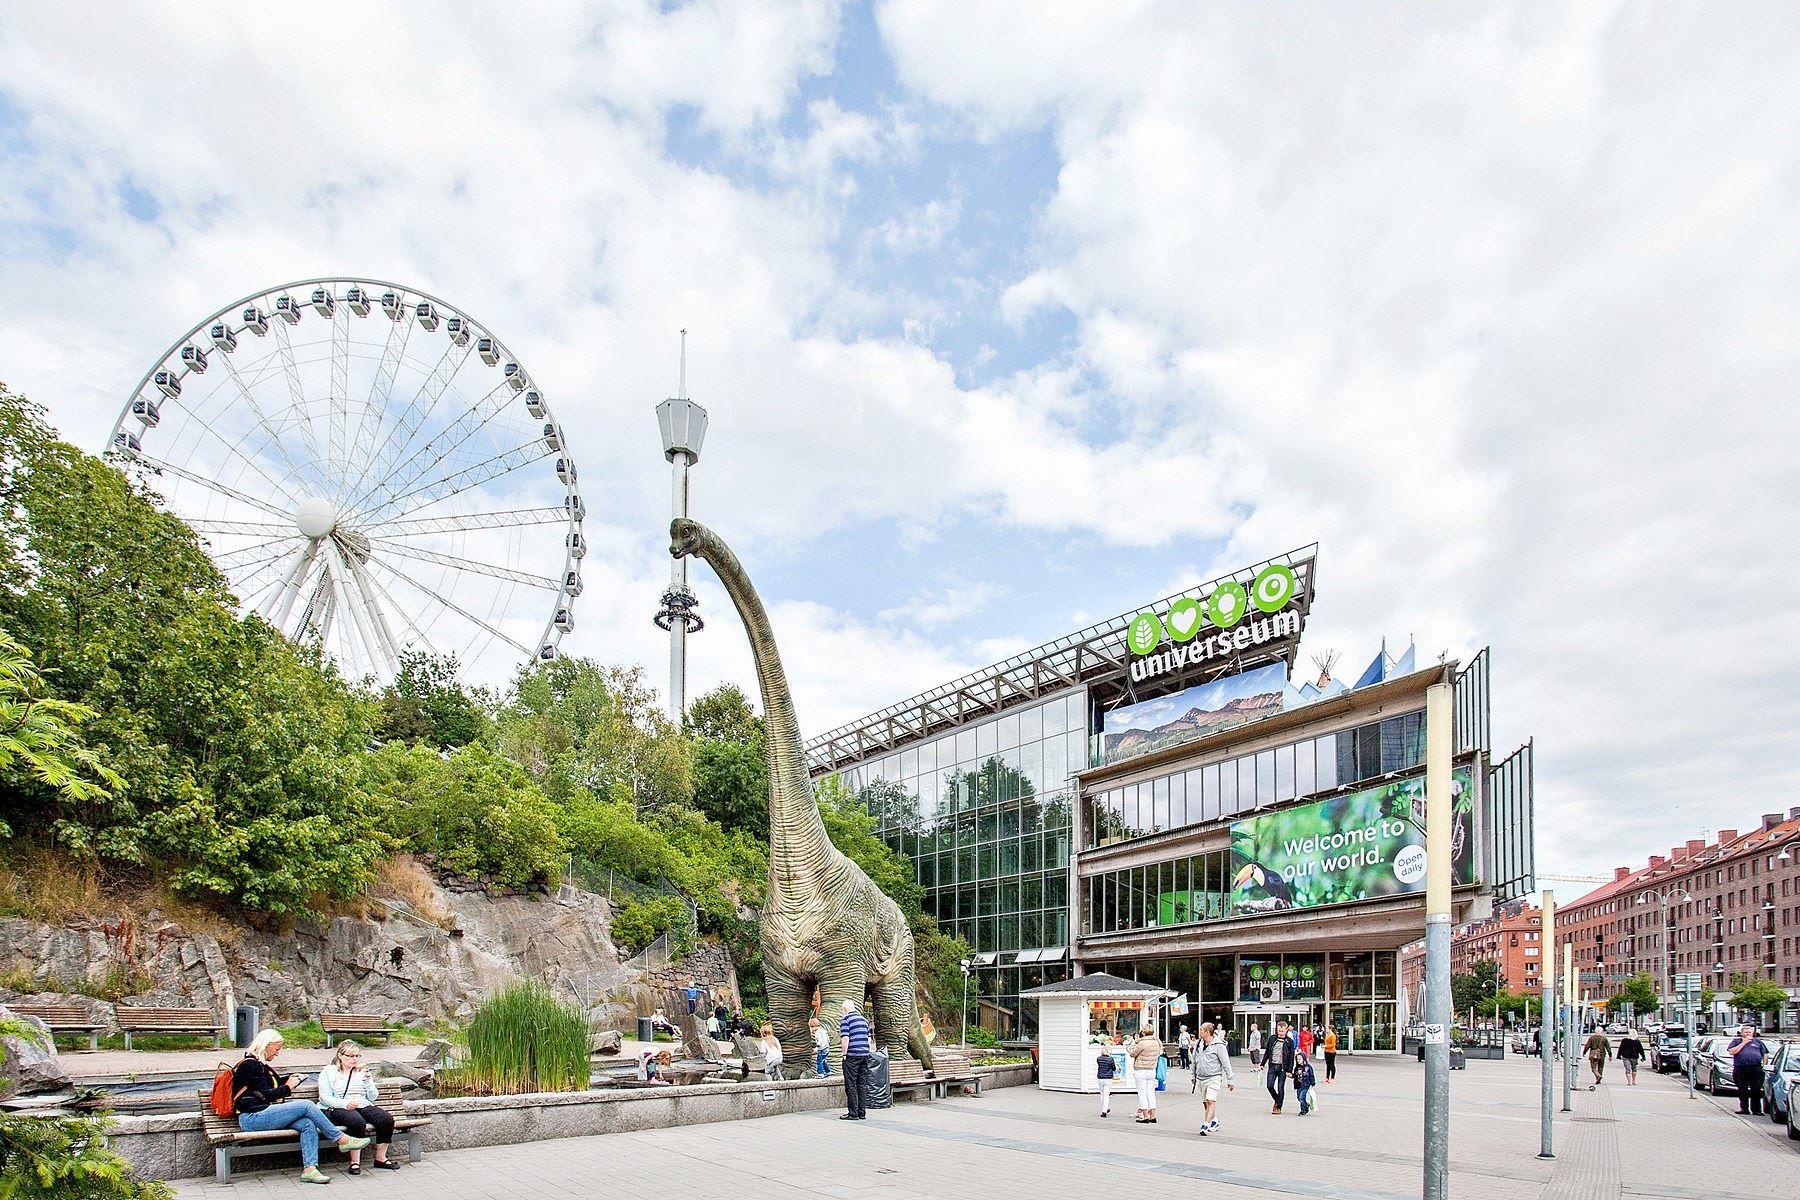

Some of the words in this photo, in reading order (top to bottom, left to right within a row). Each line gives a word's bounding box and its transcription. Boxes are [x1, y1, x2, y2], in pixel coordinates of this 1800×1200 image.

[1131, 608, 1300, 682] universeum
[1284, 826, 1377, 857] Welcome
[1382, 820, 1405, 839] to
[1284, 863, 1313, 880] our
[1320, 845, 1384, 873] world.
[1397, 853, 1423, 868] Open
[1401, 863, 1423, 877] daily
